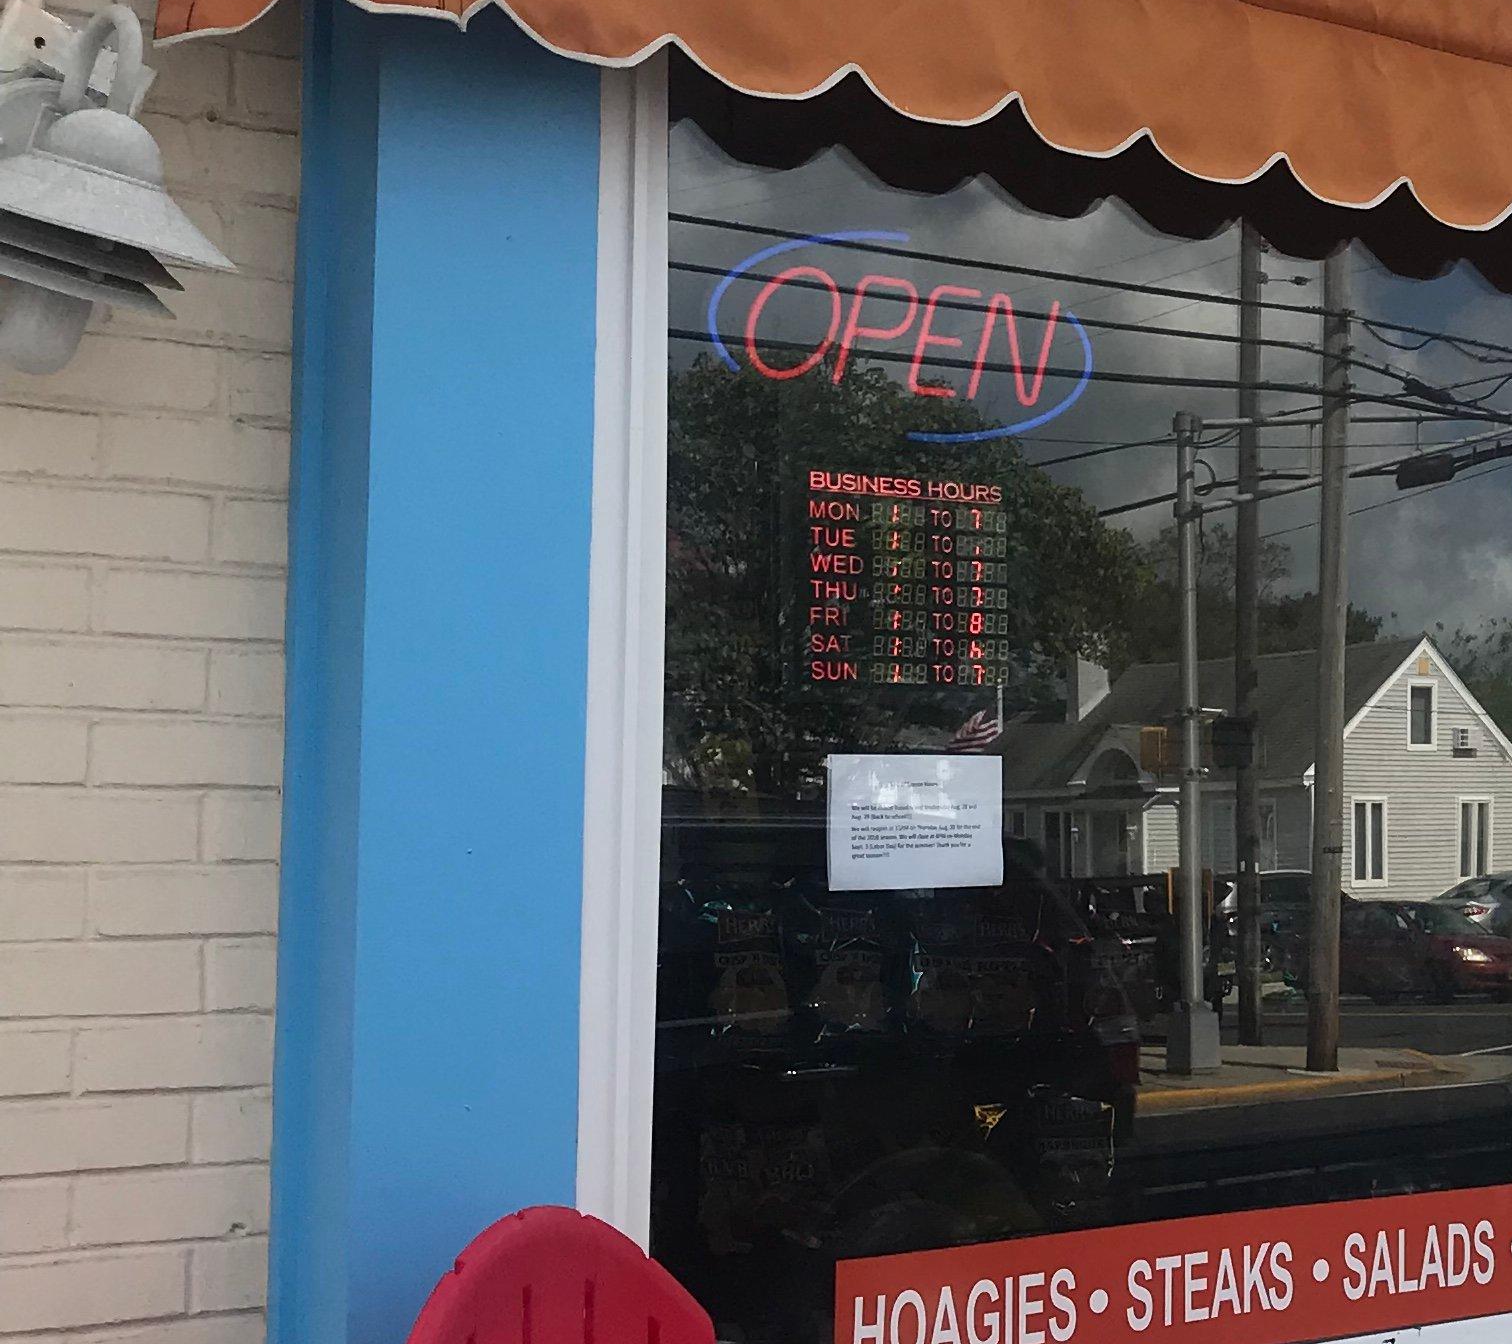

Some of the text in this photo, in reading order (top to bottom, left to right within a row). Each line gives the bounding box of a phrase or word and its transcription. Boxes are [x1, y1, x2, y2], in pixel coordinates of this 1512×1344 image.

[745, 266, 1060, 407] OPEN
[809, 470, 1003, 503] BUSINESS HOURS
[809, 500, 860, 522] MON
[930, 509, 952, 528] TO
[810, 526, 856, 548] TUE
[931, 535, 953, 553] TO
[810, 553, 864, 575] WED
[931, 560, 953, 579] TO
[810, 579, 857, 601] THU
[931, 586, 953, 605] TO
[810, 606, 848, 626] FRI
[932, 612, 954, 630] TO
[811, 633, 852, 653] SAT
[932, 638, 955, 656] TO
[811, 660, 857, 681] SUN
[932, 664, 954, 683] TO
[1127, 1242, 1294, 1331] STEAKS
[1343, 1220, 1495, 1301] SALADS
